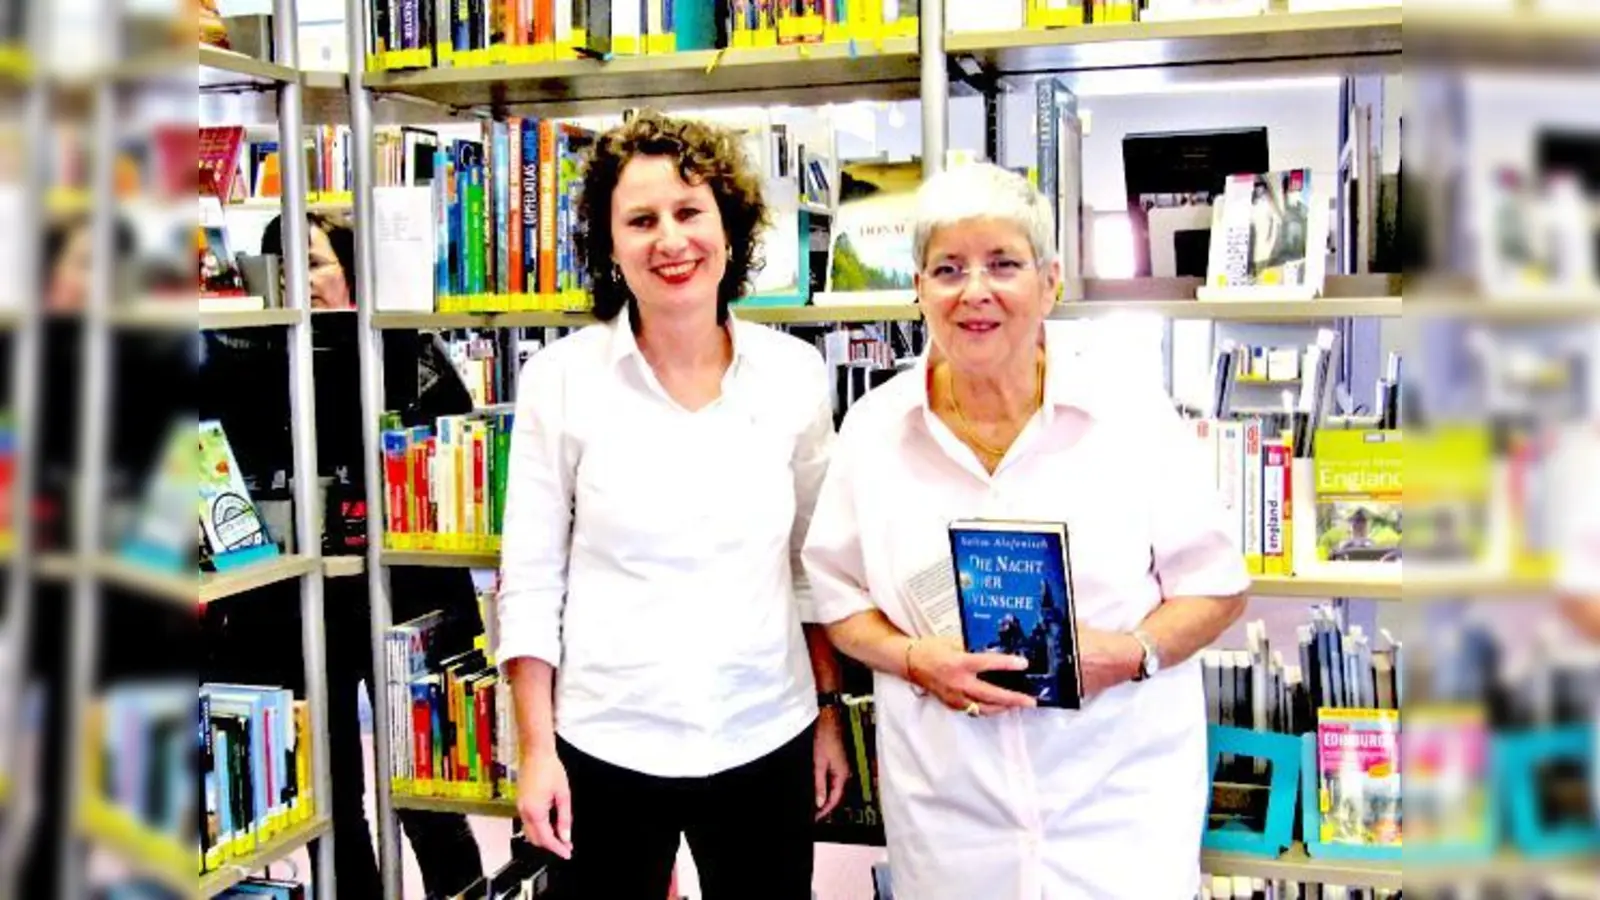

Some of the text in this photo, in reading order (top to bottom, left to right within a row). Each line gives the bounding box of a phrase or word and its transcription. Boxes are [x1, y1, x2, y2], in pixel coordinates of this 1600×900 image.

[523, 164, 537, 225] GIPFELATLAS
[1267, 499, 1280, 550] england
[969, 554, 1044, 575] DIE NACHT
[1323, 732, 1395, 747] EDINBURG
